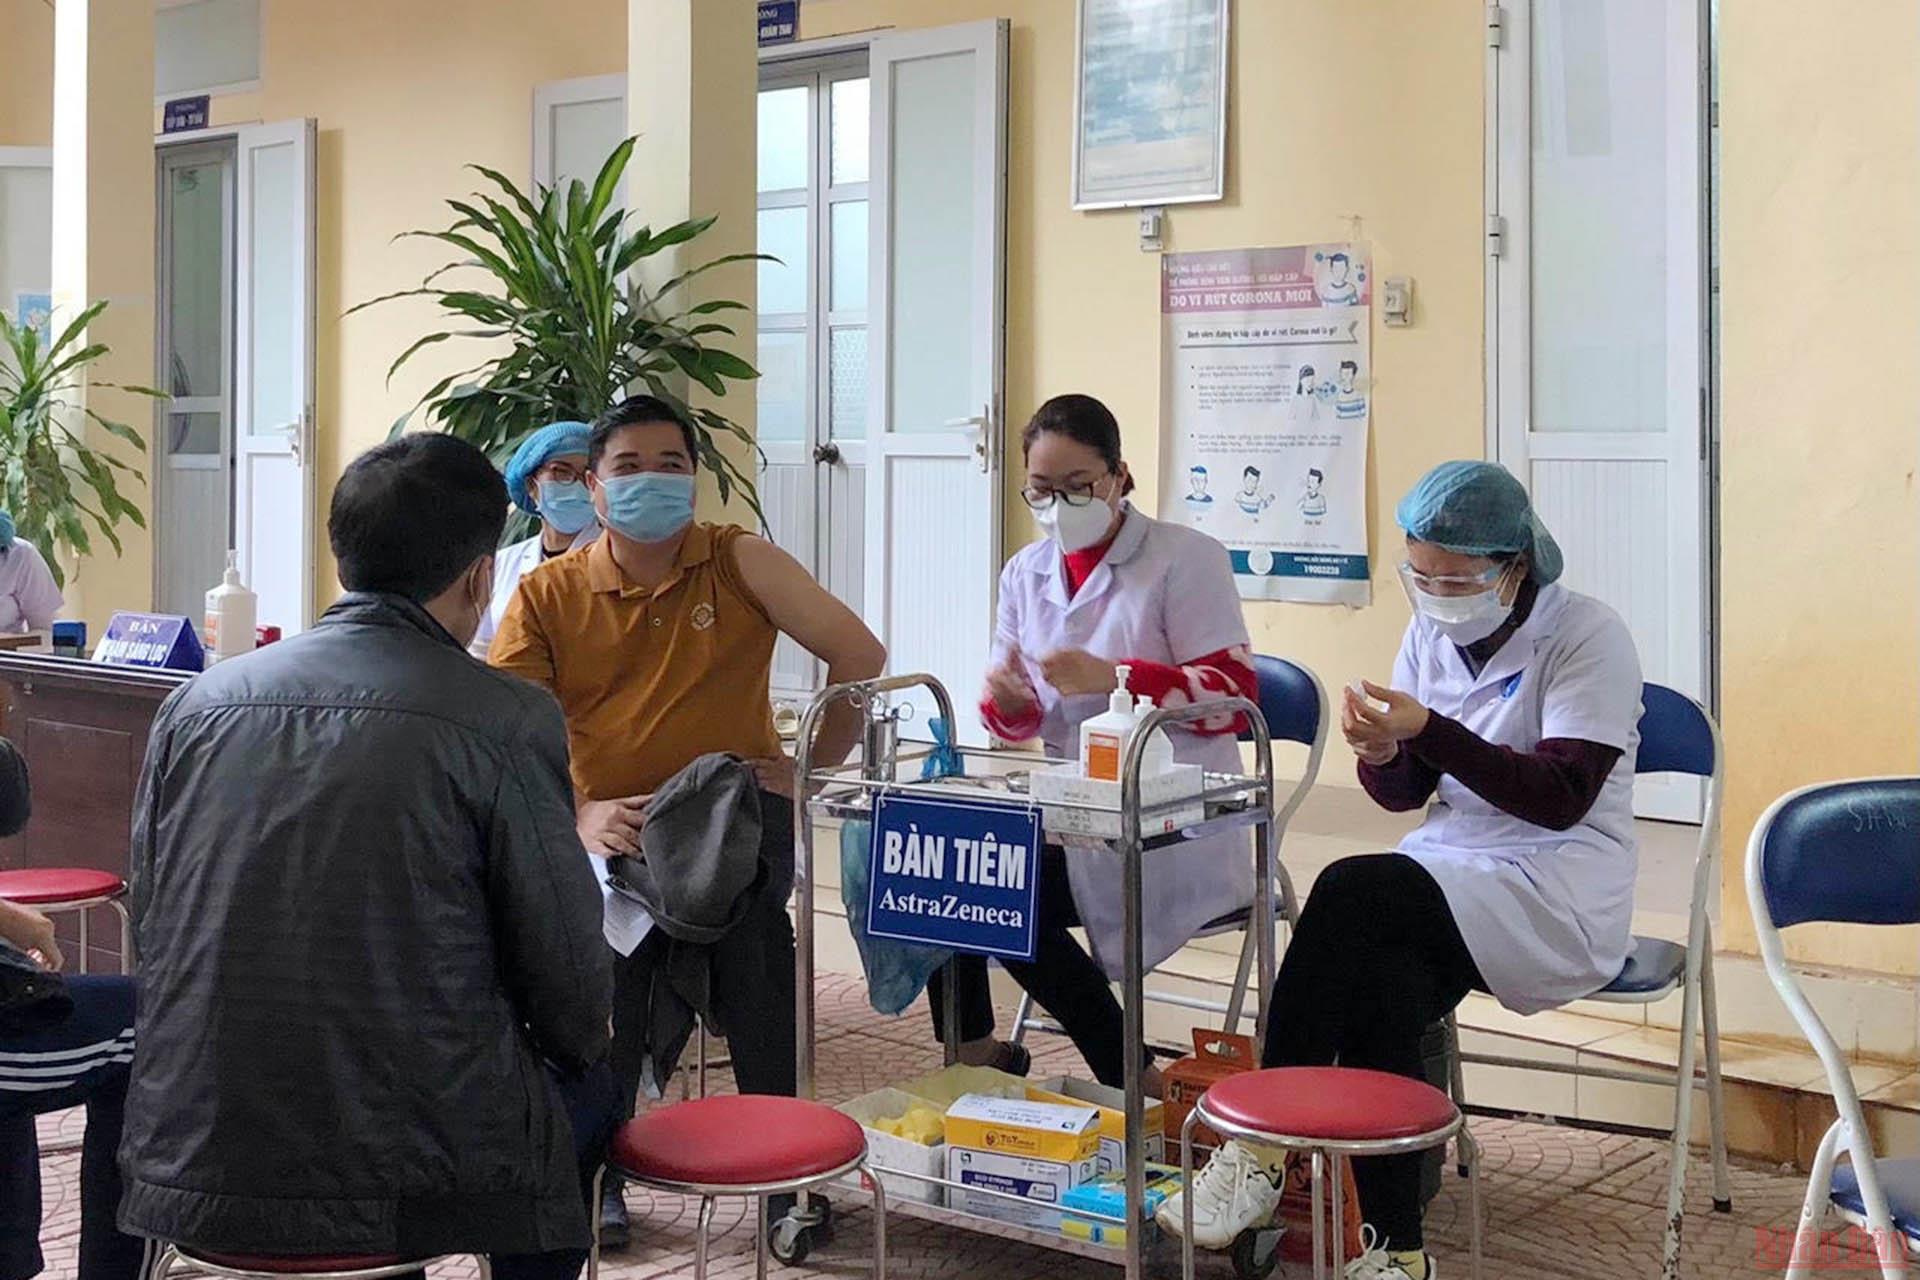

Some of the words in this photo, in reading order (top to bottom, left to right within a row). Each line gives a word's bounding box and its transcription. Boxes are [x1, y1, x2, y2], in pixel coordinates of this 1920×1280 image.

[1230, 290, 1282, 304] CORONA
[883, 823, 945, 880] BÀN
[954, 831, 1026, 890] TIÊM
[878, 887, 1023, 928] AstraZeneca
